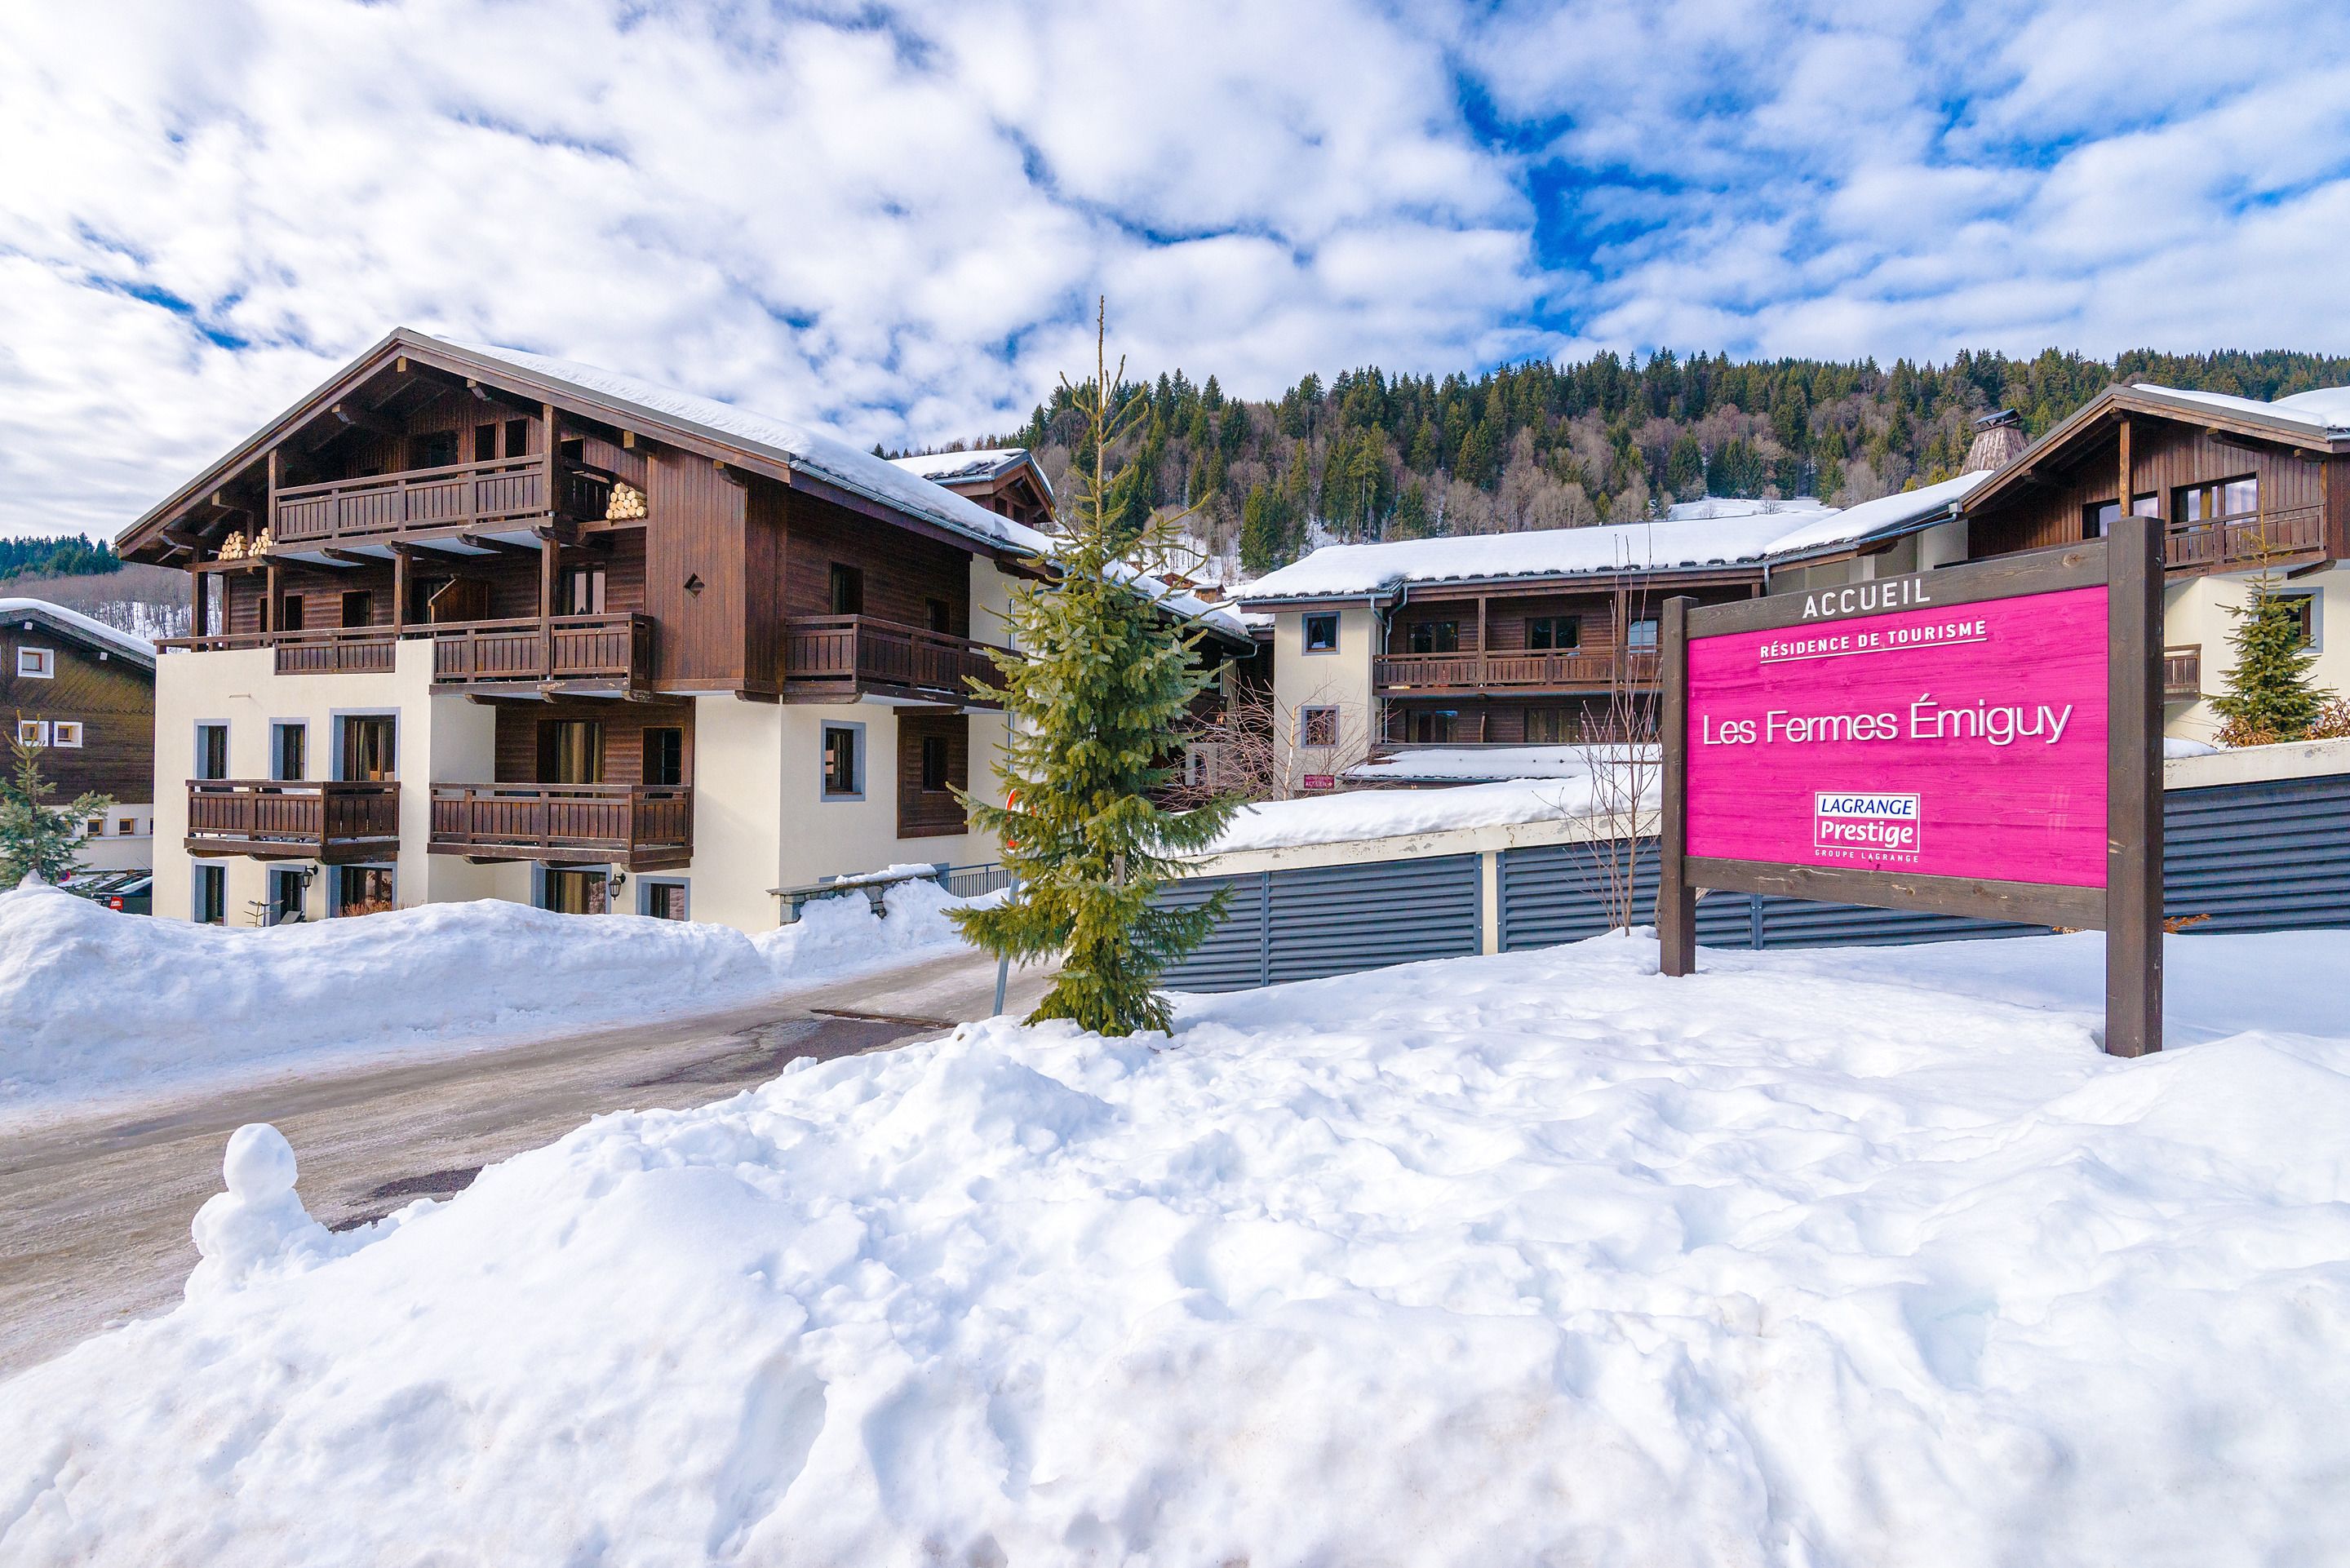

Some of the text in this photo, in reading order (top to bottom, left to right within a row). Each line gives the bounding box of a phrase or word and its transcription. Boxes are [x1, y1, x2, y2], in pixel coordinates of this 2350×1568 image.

[1802, 578, 1931, 618] ACCUEIL
[1760, 620, 1986, 658] RÉSIDENCE DE TOURISME
[1703, 693, 2074, 746] Les Fermes Émiguy
[1821, 798, 1913, 815] LAGRANGE
[1820, 821, 1913, 848] Prestige
[1815, 849, 1918, 863] GROUPE LAGRANGE
